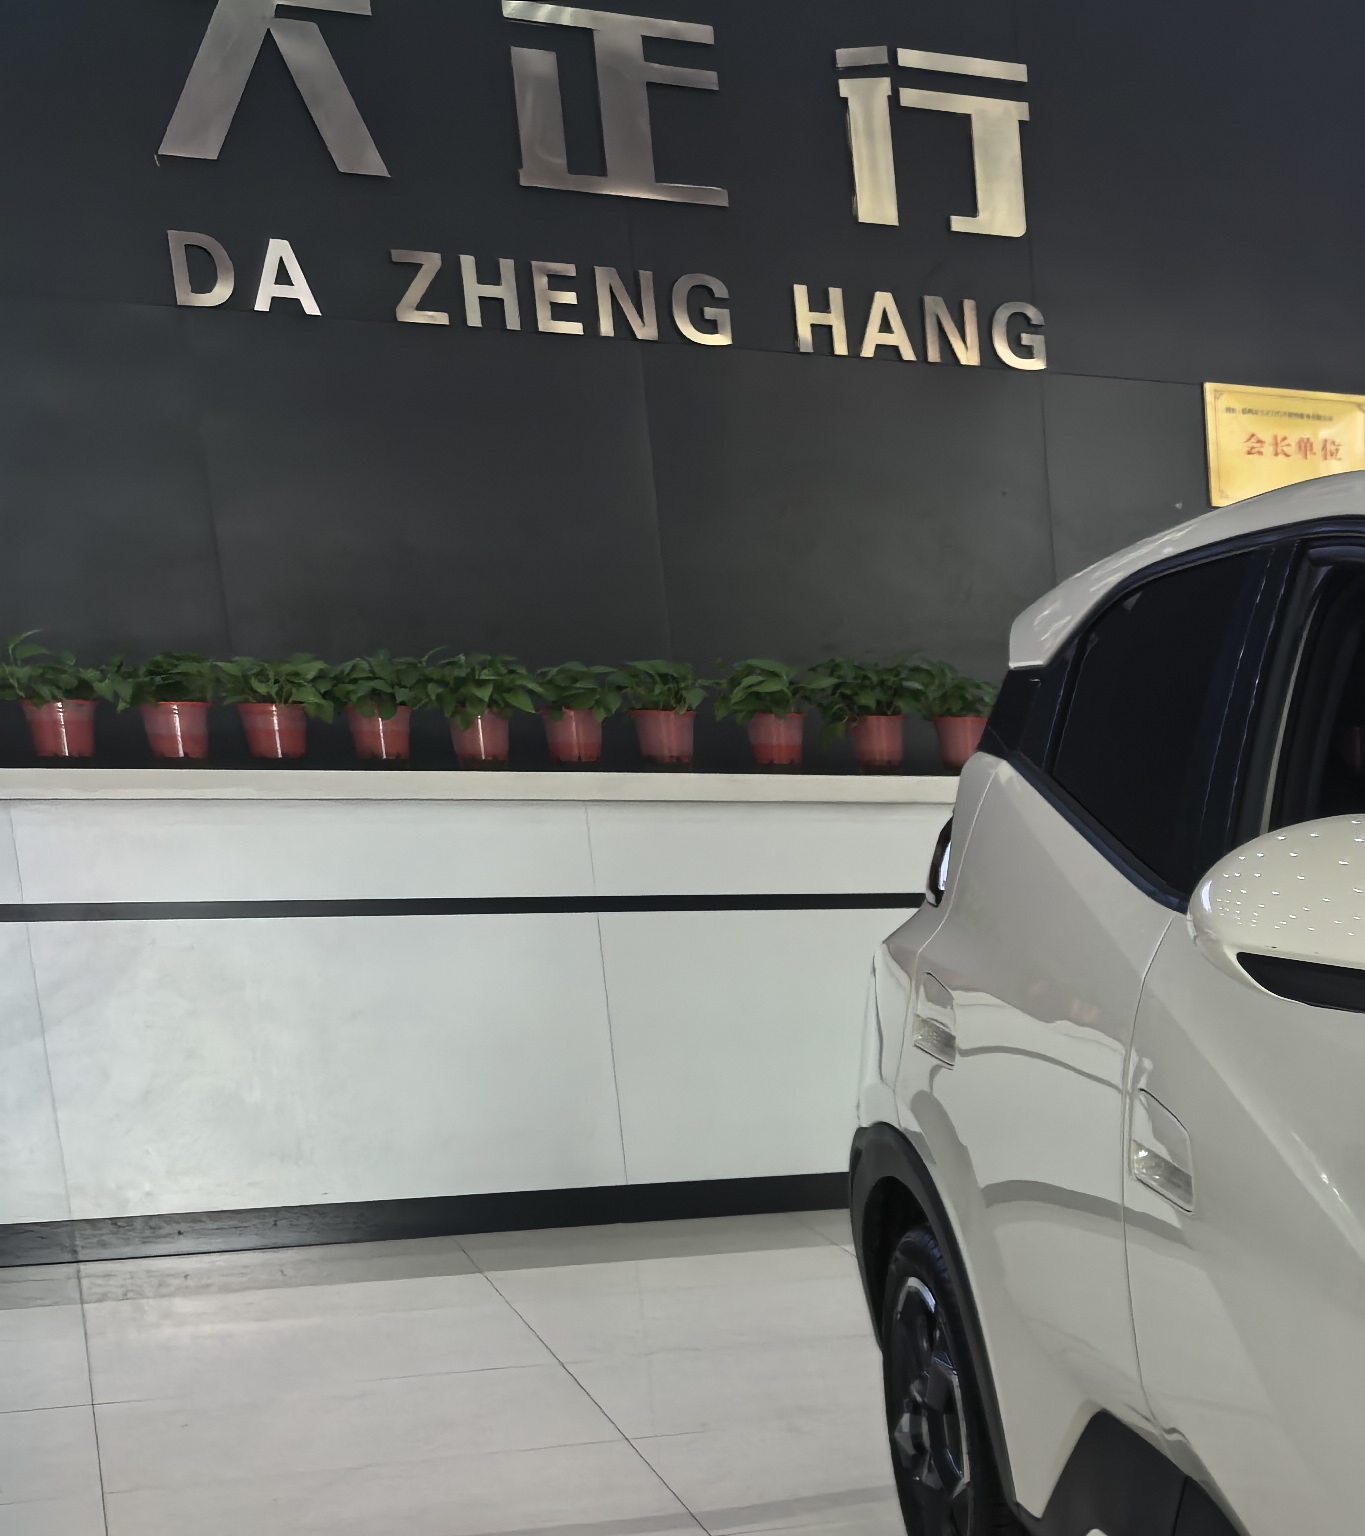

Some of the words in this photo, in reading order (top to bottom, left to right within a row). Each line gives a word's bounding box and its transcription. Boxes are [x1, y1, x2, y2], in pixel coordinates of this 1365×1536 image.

[156, 0, 1030, 238] 大正行
[167, 229, 321, 316] DA
[390, 249, 733, 347] ZHENG
[792, 283, 1048, 371] HANG
[1243, 432, 1344, 462] 会长单位
